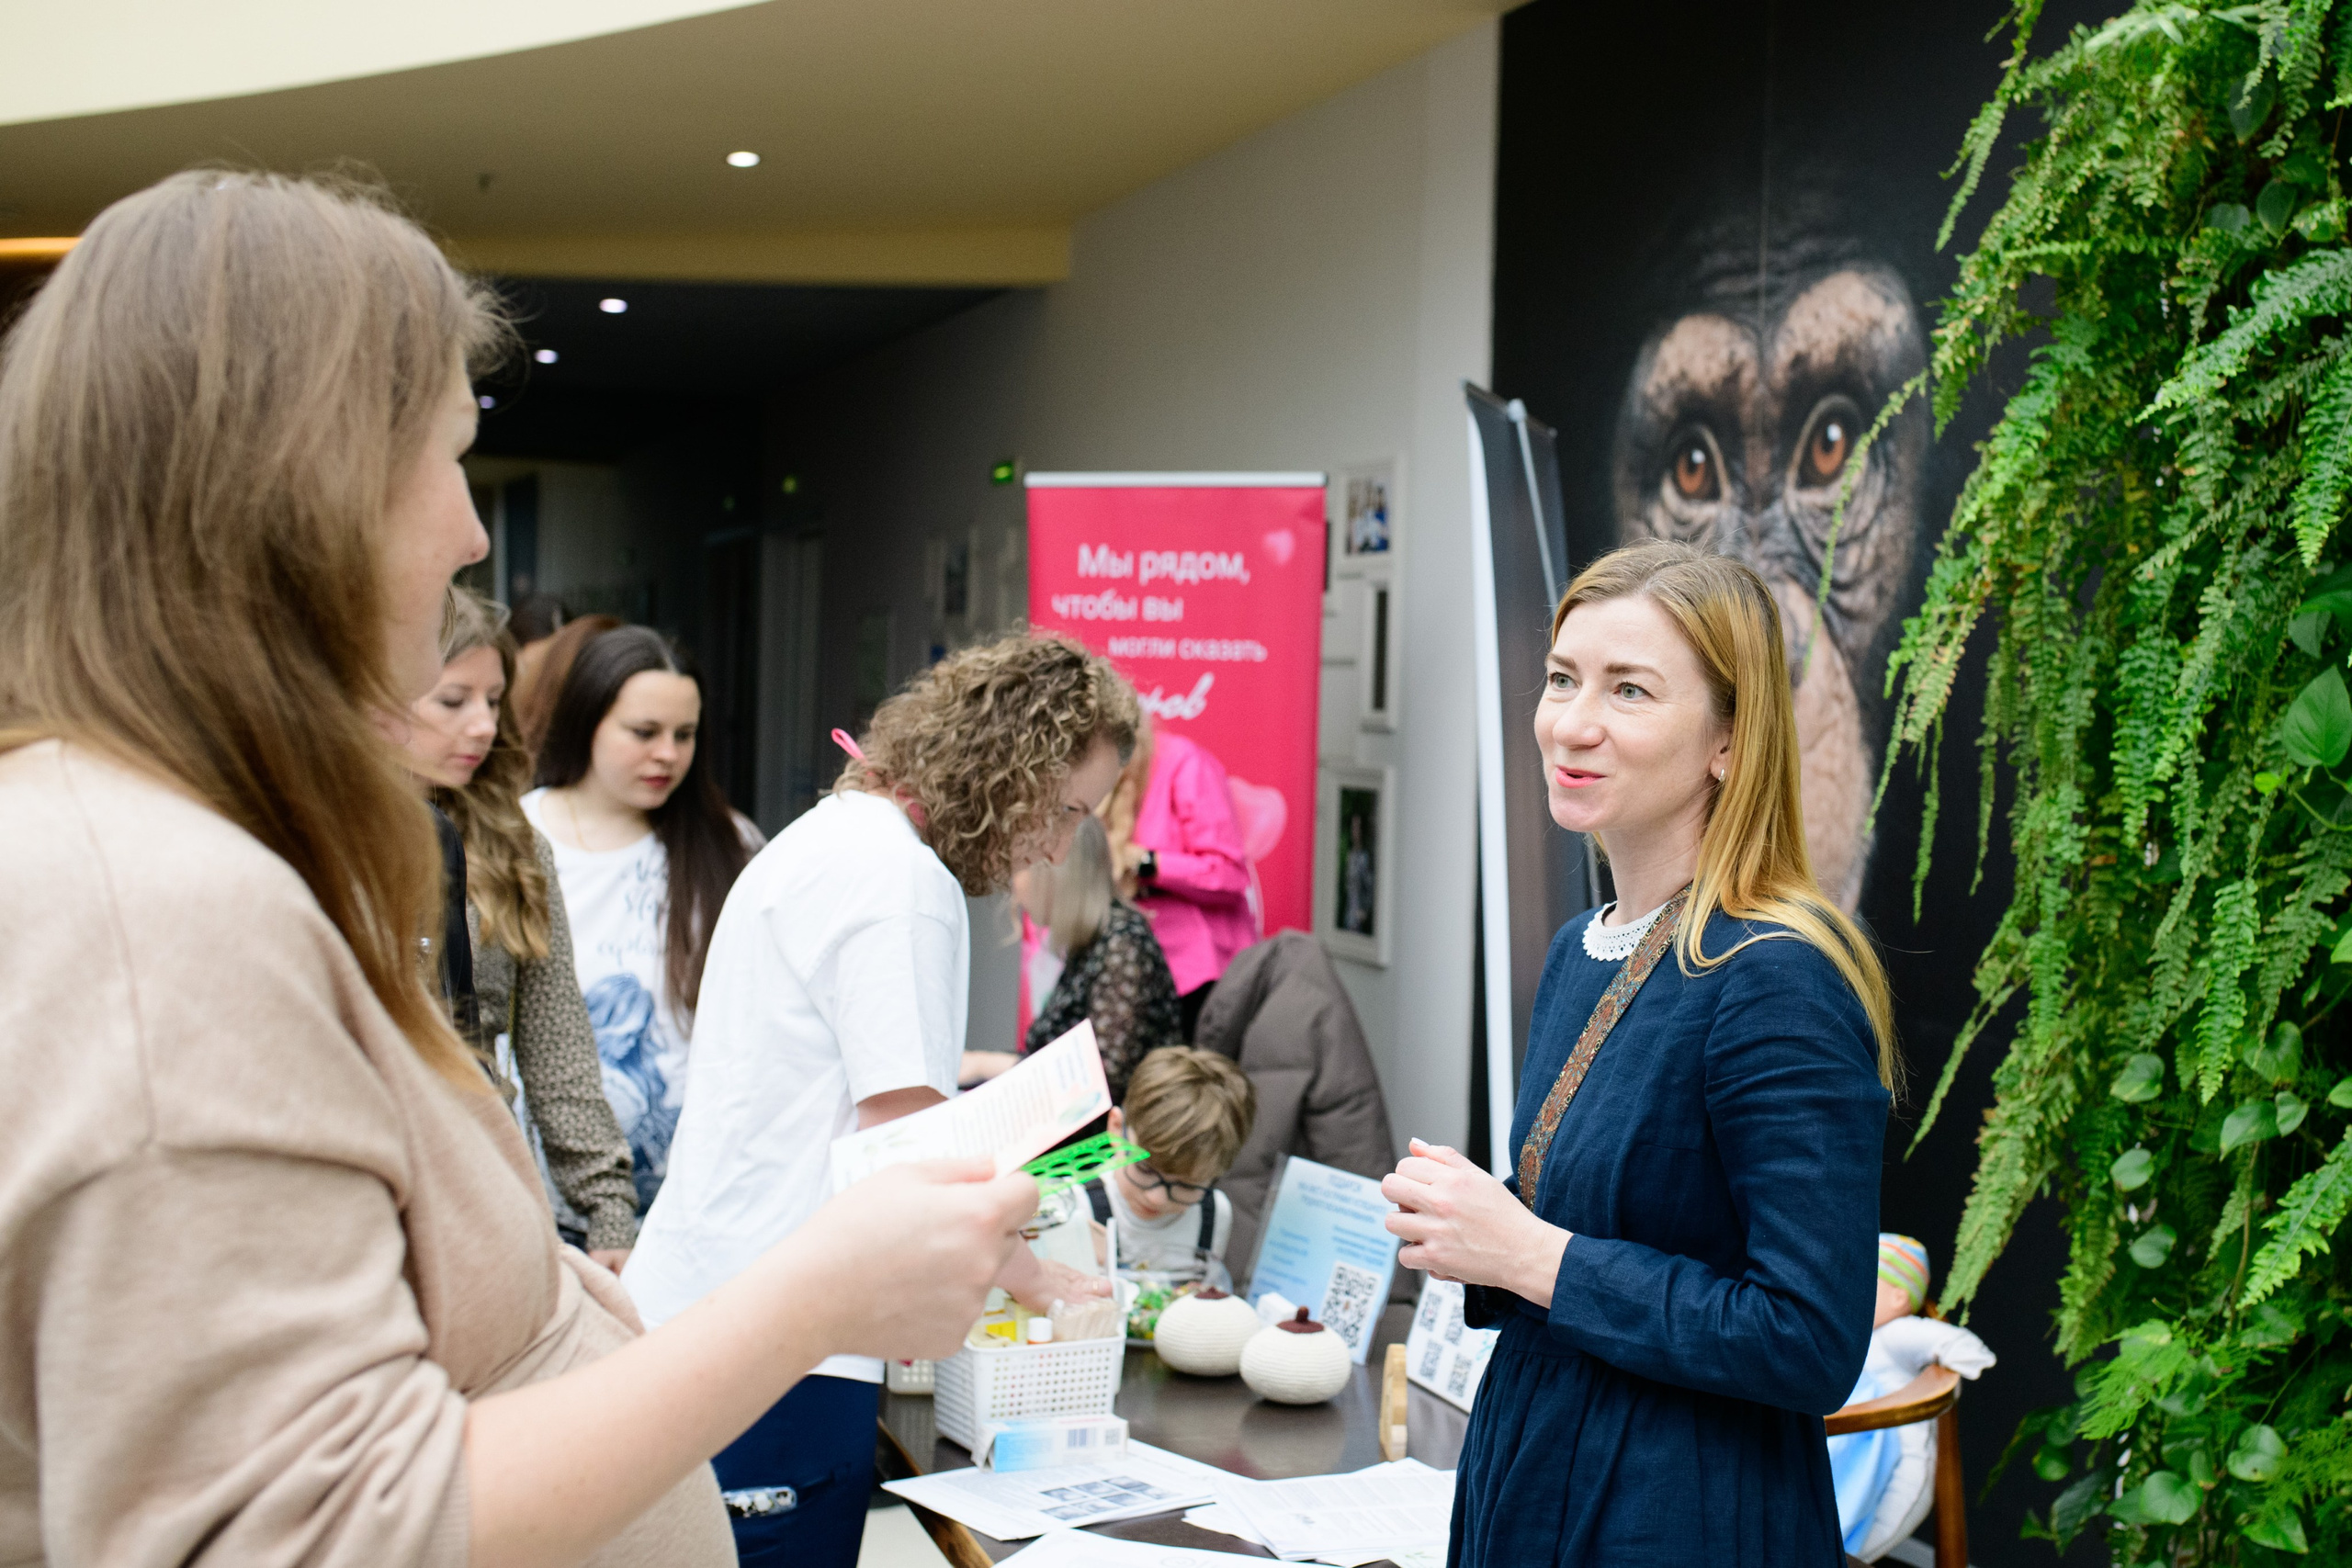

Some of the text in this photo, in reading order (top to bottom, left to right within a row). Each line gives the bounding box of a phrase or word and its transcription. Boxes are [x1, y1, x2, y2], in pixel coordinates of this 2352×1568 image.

[1078, 543, 1250, 585] Мы рядом,
[1051, 589, 1184, 621] чтобы вы
[1108, 637, 1268, 662] могли сказать
